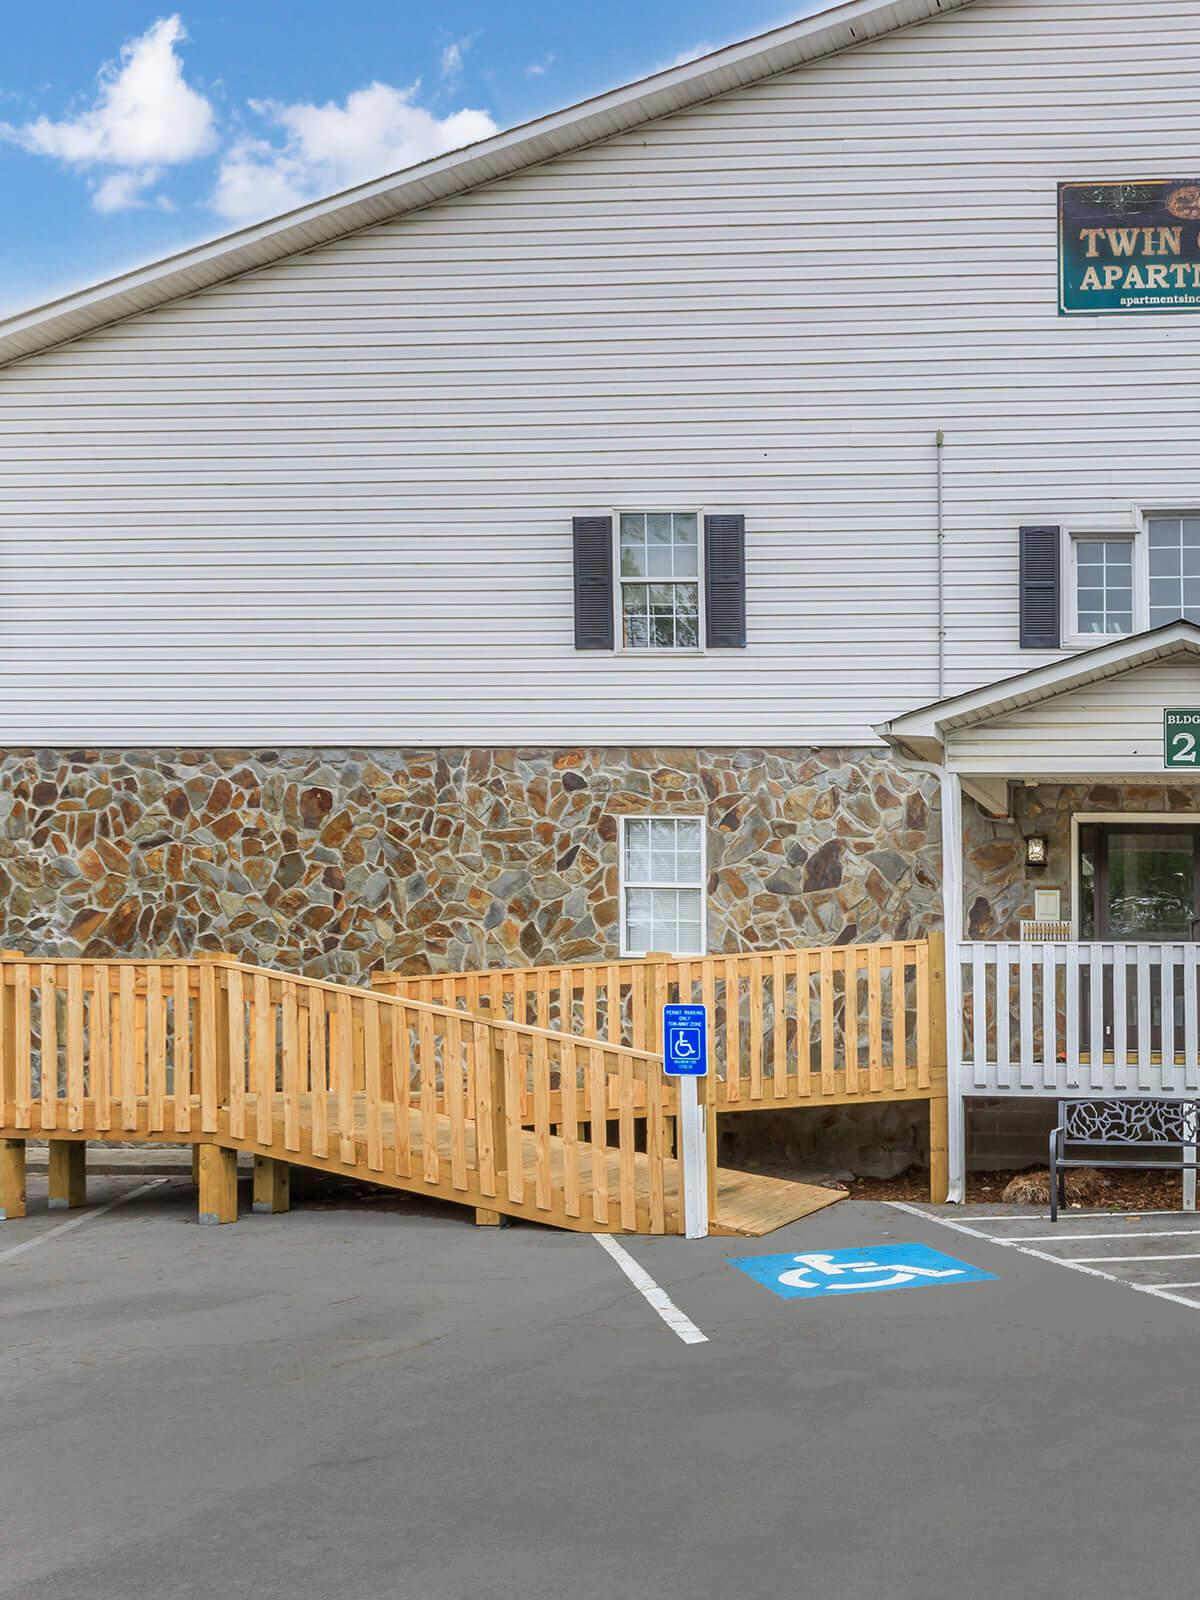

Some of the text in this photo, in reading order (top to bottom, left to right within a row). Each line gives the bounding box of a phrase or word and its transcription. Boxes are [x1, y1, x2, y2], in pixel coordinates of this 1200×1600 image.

[1079, 225, 1183, 258] TWIN
[1167, 715, 1200, 724] BLDG
[1172, 732, 1197, 762] 2
